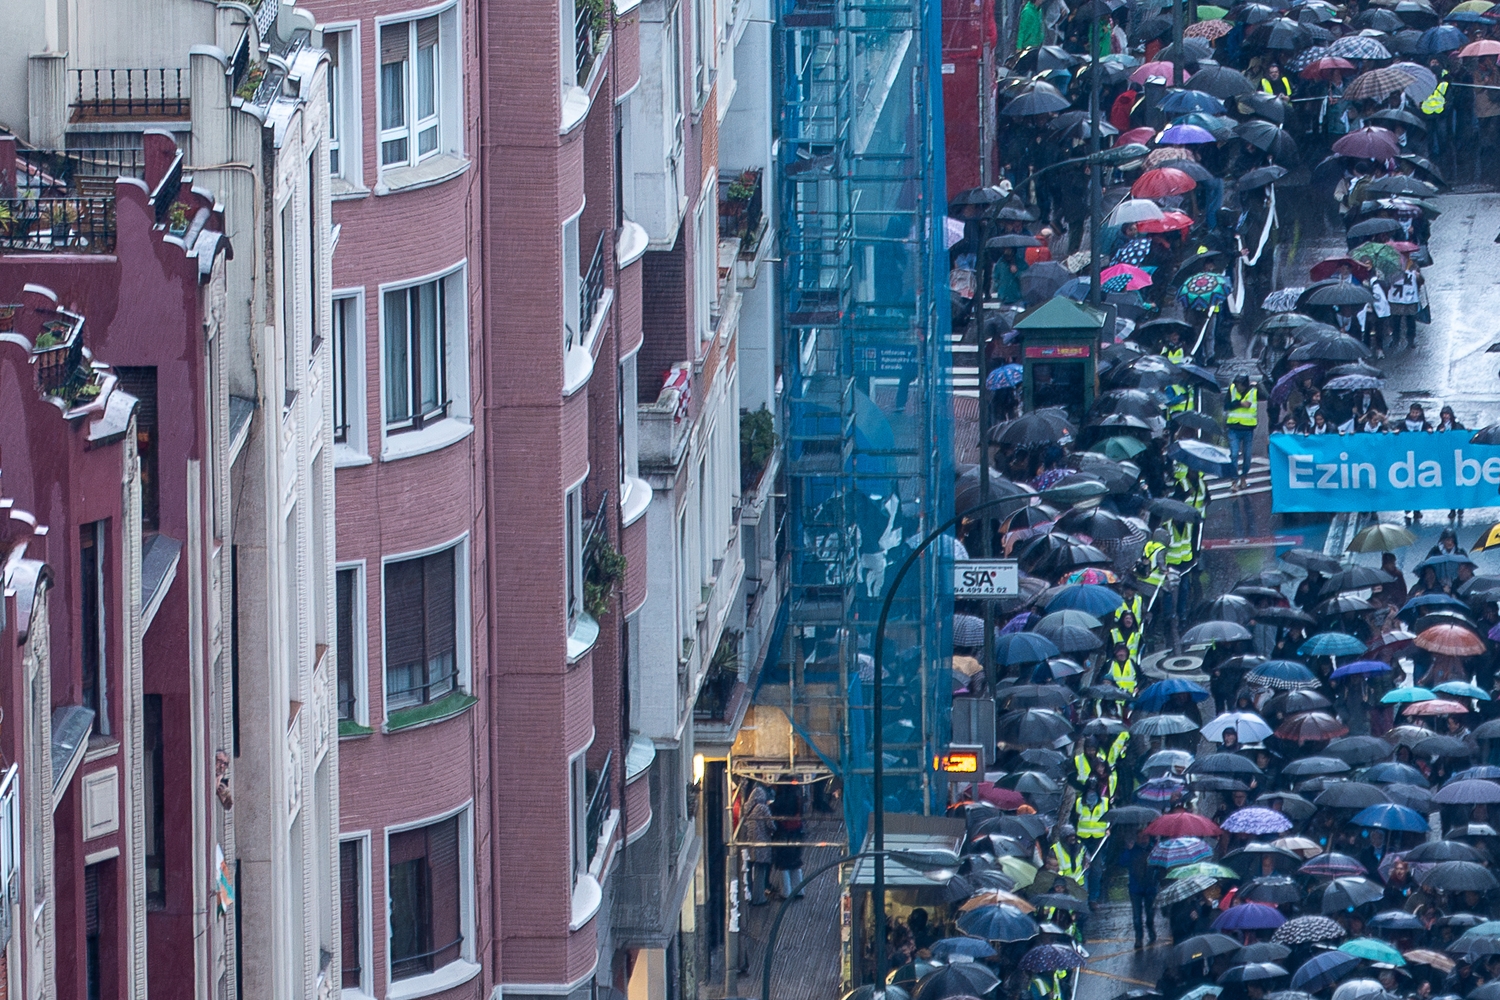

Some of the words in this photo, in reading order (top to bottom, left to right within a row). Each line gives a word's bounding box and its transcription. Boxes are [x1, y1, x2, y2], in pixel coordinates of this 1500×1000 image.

[1288, 451, 1377, 489] Ezin
[1388, 450, 1442, 488] da
[962, 570, 993, 587] STA
